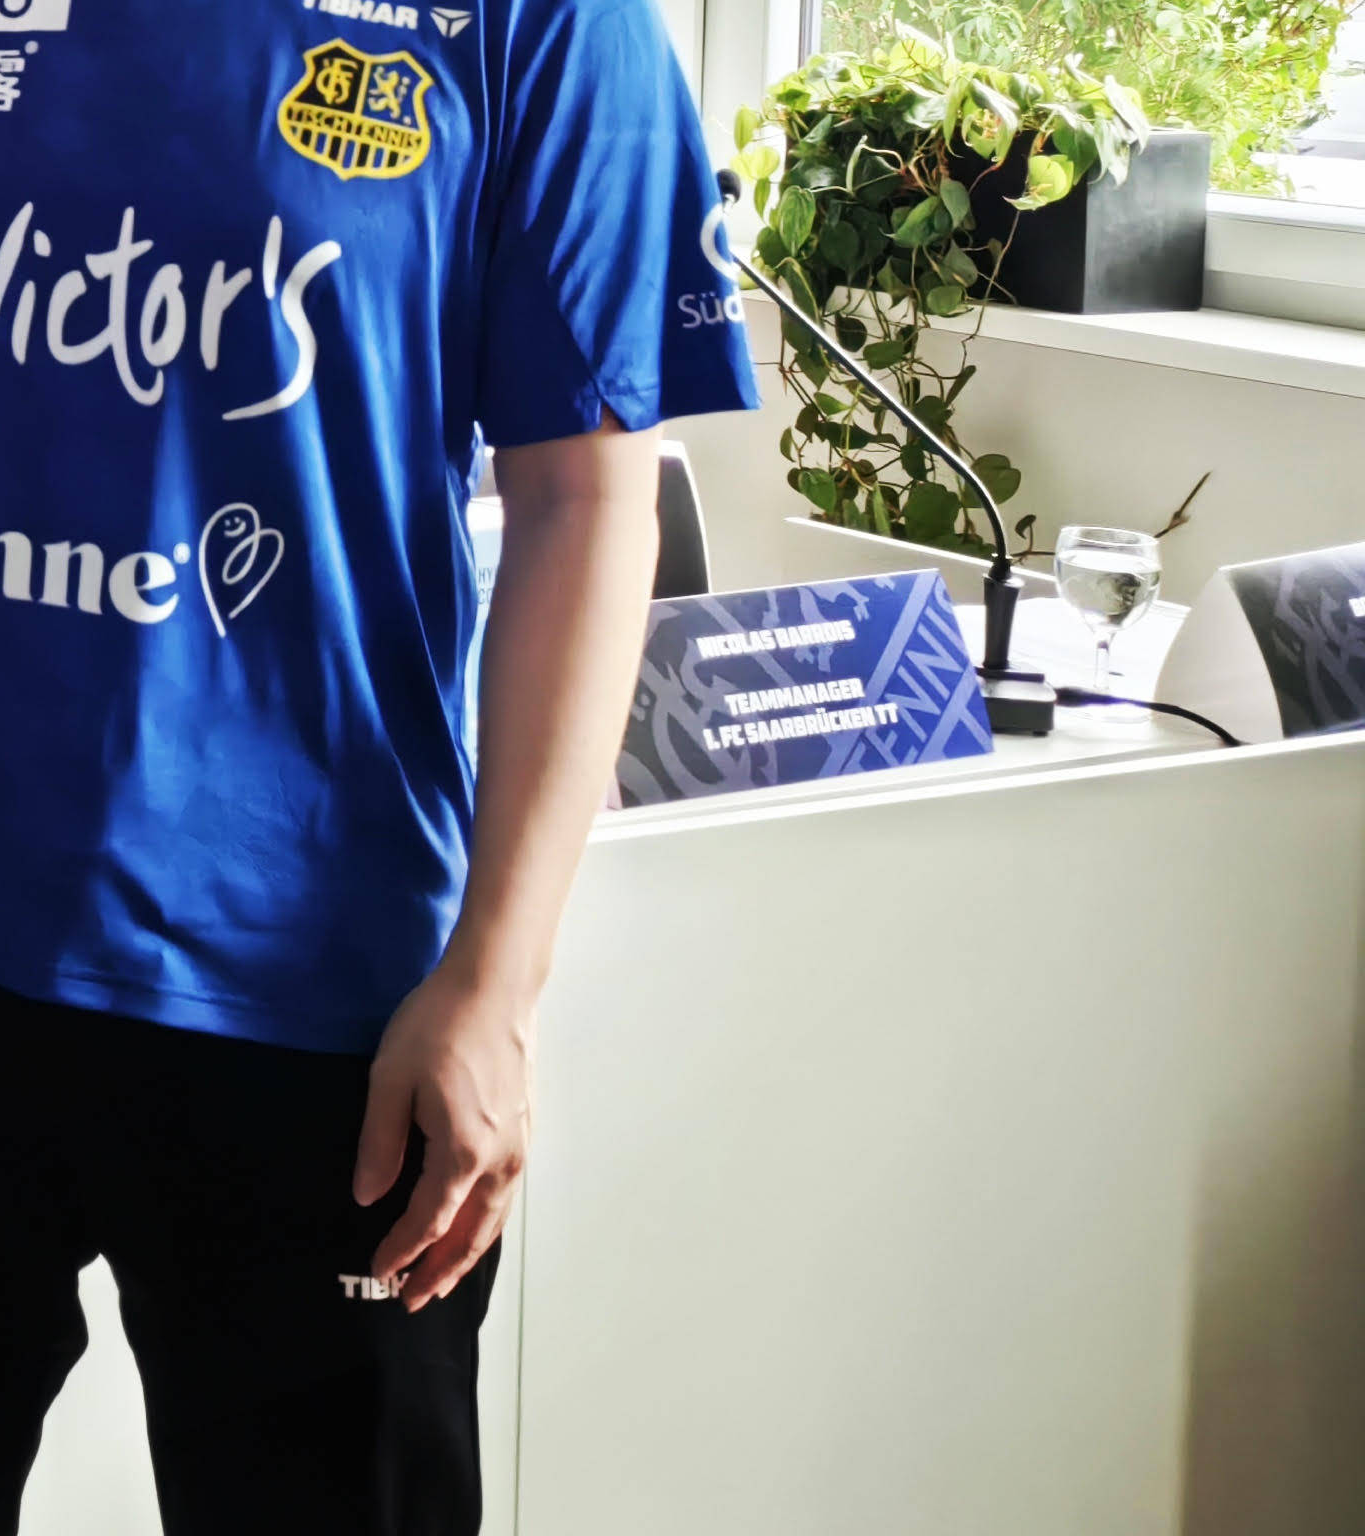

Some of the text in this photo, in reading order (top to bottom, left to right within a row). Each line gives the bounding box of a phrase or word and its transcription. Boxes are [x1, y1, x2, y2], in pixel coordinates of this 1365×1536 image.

[287, 106, 423, 151] TISCHTENNIS
[677, 291, 746, 329] Süd
[696, 629, 775, 659] NICOLAS
[724, 677, 866, 716] TEAMMANAGER
[721, 724, 745, 748] FC
[746, 707, 876, 744] SAARBRÜCKEN
[876, 702, 899, 725] TT
